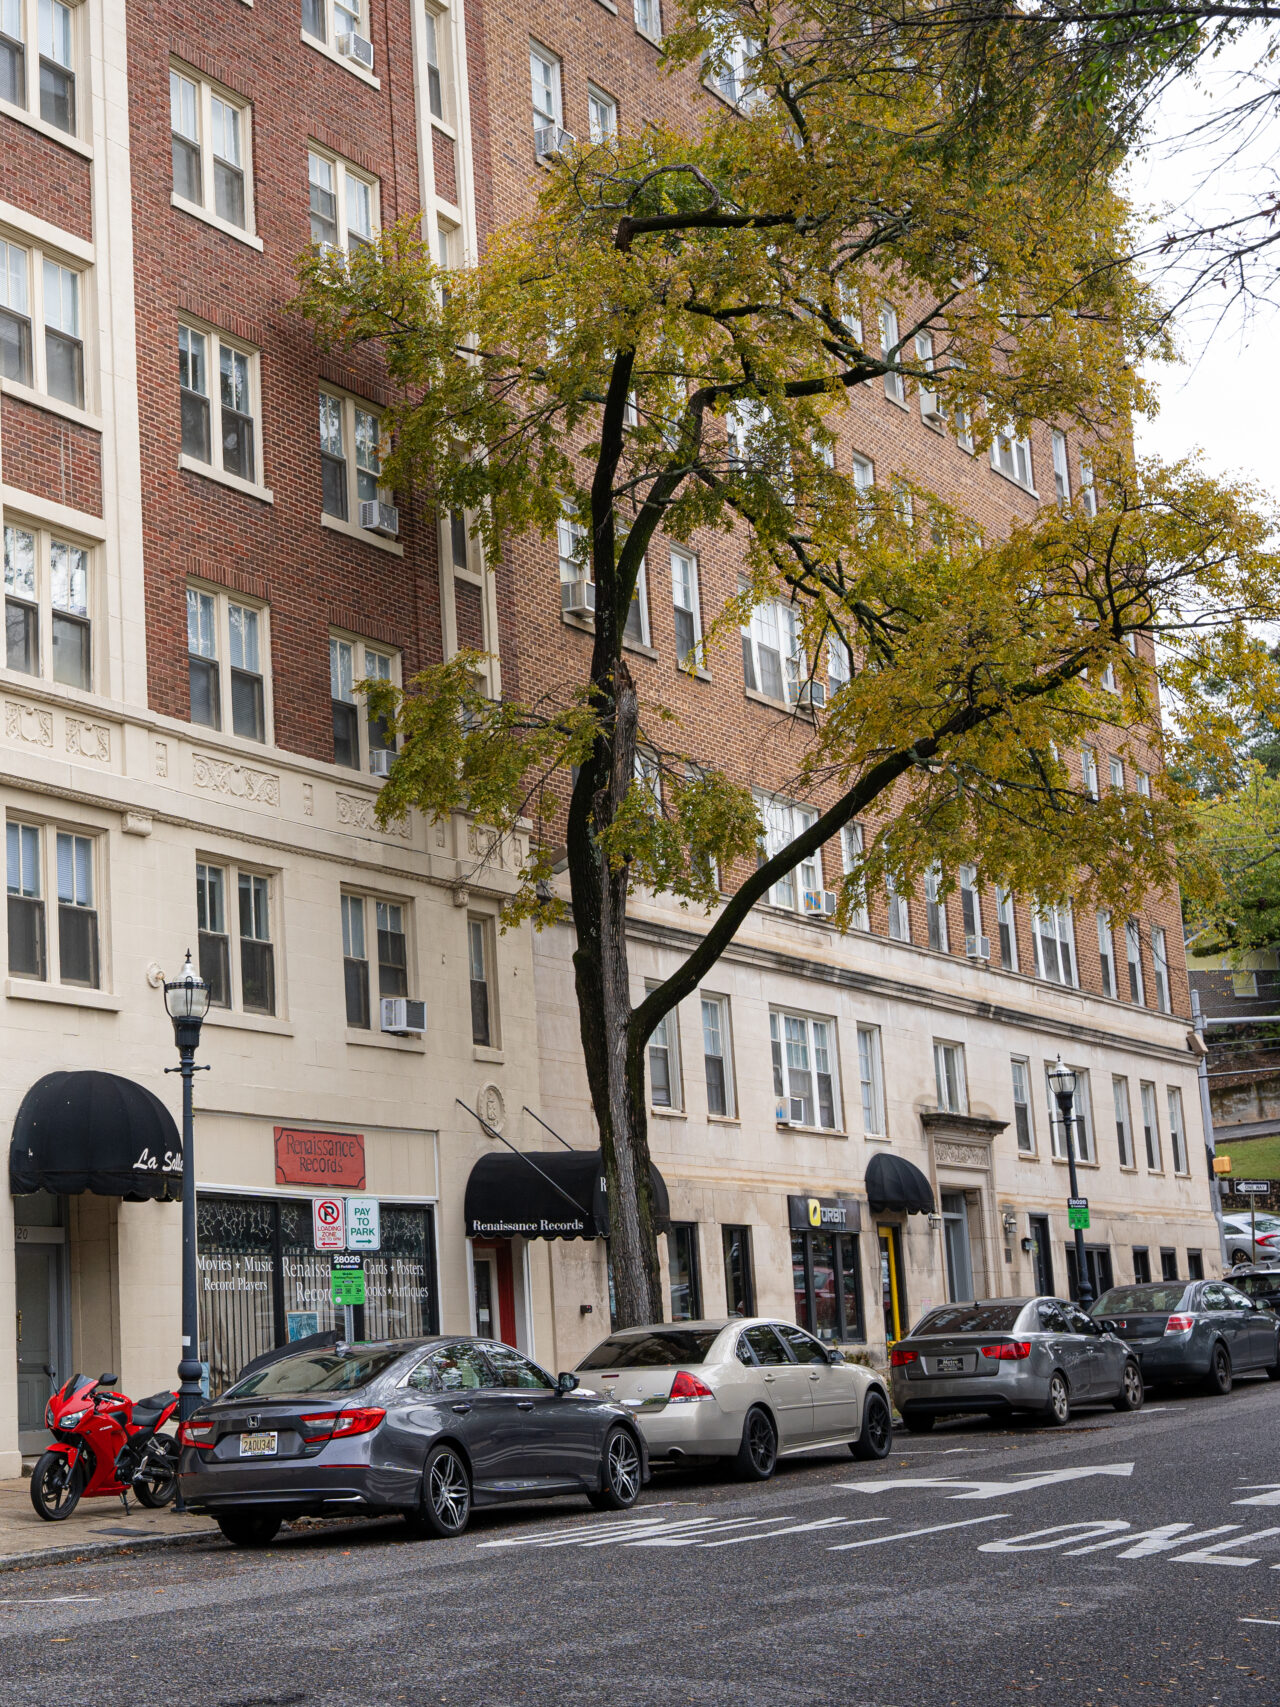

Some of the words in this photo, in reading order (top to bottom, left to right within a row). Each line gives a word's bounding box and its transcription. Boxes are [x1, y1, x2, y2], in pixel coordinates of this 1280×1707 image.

[286, 1134, 355, 1158] Renaissance
[132, 1148, 158, 1170] La
[300, 1157, 343, 1173] Records
[354, 1207, 371, 1216] PAY
[821, 1208, 846, 1223] ORBIT
[356, 1217, 370, 1226] TO
[473, 1220, 537, 1231] Renaissance
[540, 1219, 584, 1231] Records
[15, 1226, 29, 1240] 20
[350, 1228, 375, 1236] PARK
[196, 1254, 232, 1271] Movies
[245, 1256, 274, 1272] Music
[282, 1257, 331, 1277] Renaissa
[333, 1255, 361, 1264] 28026
[363, 1259, 388, 1275] Cards
[397, 1259, 424, 1275] Posters
[204, 1277, 234, 1291] Record
[241, 1277, 268, 1294] Players
[296, 1282, 332, 1301] Recor
[392, 1282, 429, 1303] Antiques
[977, 1520, 1280, 1570] ONL
